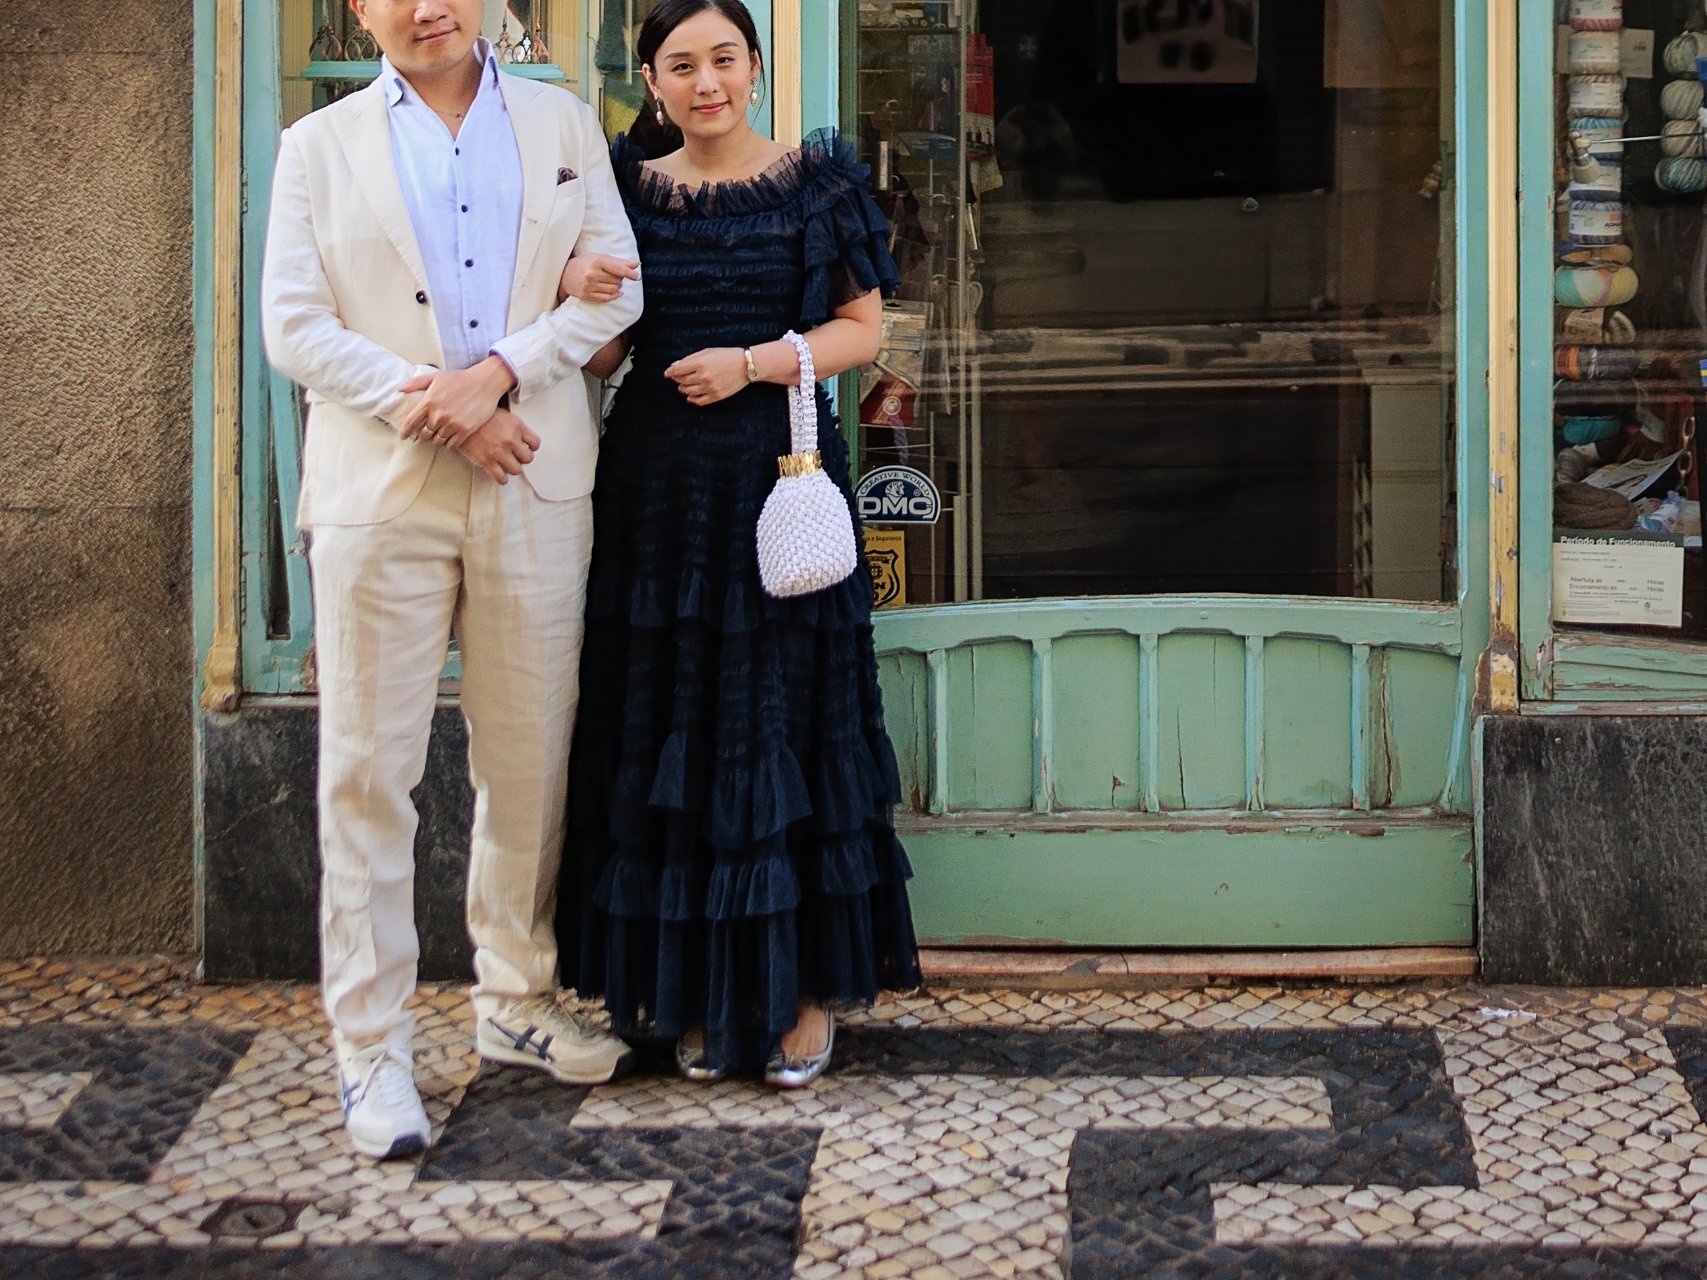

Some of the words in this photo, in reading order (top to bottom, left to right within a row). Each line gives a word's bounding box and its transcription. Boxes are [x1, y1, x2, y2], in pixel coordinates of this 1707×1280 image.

[860, 472, 900, 495] CREATIVE
[902, 472, 930, 496] WORLD
[858, 496, 934, 515] DMC
[1560, 536, 1595, 545] Período
[1609, 538, 1676, 548] Funcionamento
